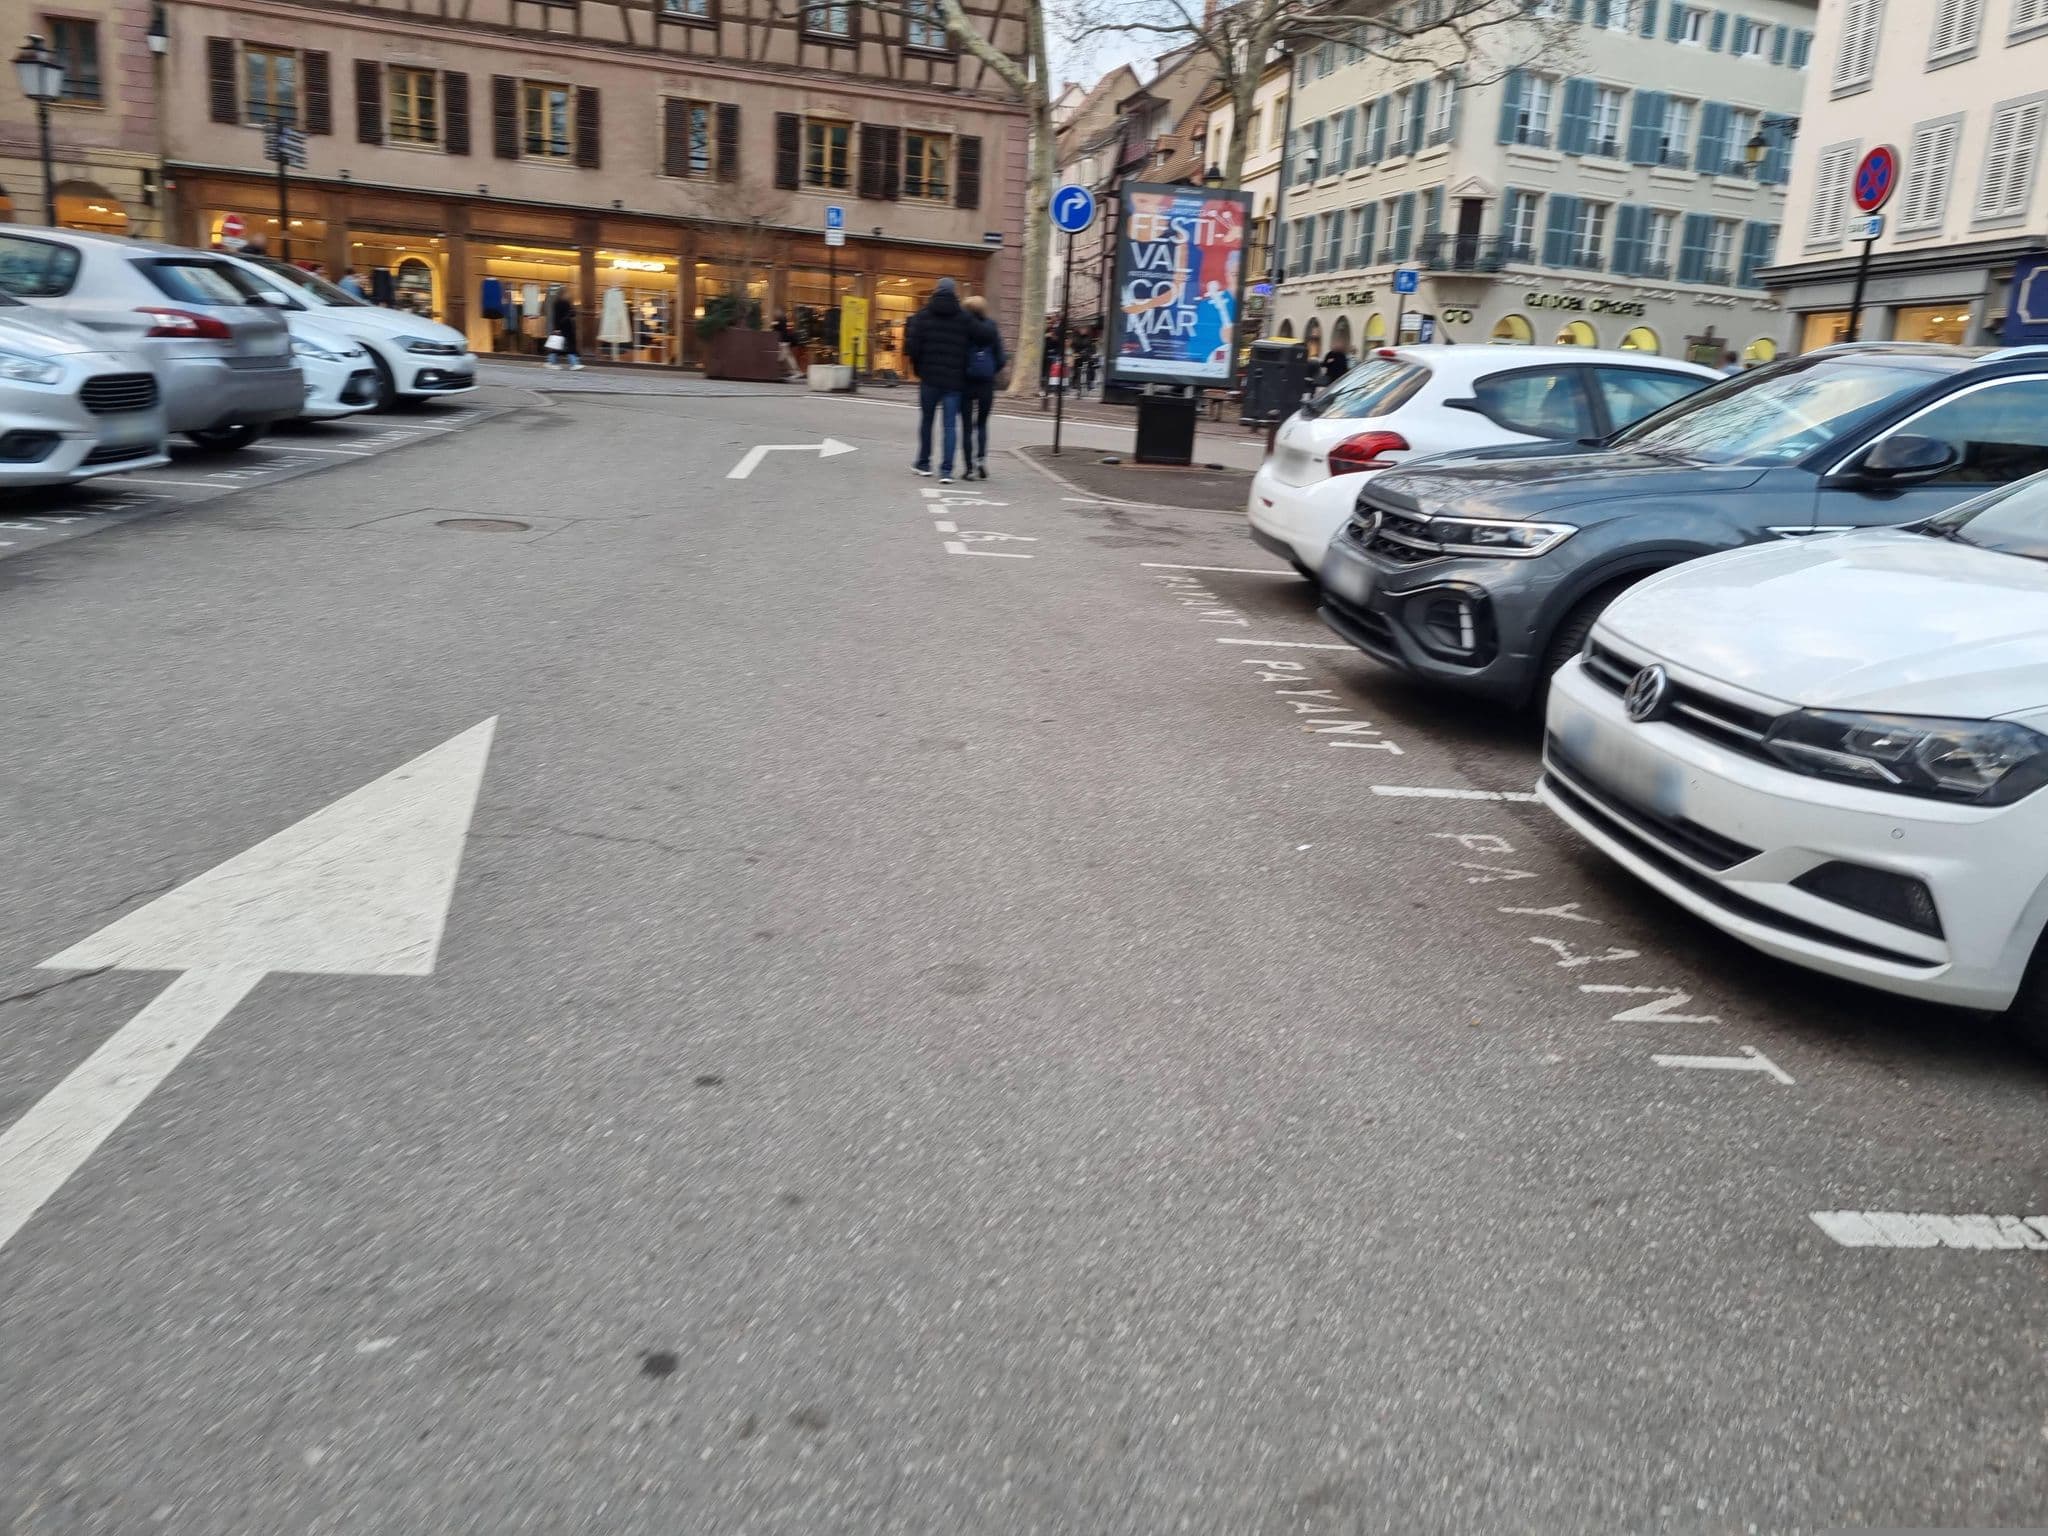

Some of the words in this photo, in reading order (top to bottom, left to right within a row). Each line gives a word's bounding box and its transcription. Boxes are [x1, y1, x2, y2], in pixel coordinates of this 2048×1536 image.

[1131, 213, 1224, 246] FESTI-
[1131, 242, 1193, 272] VAL
[1127, 308, 1198, 337] MAR
[1242, 659, 1405, 756] PAYANT
[1429, 832, 1795, 1085] PAYANT
